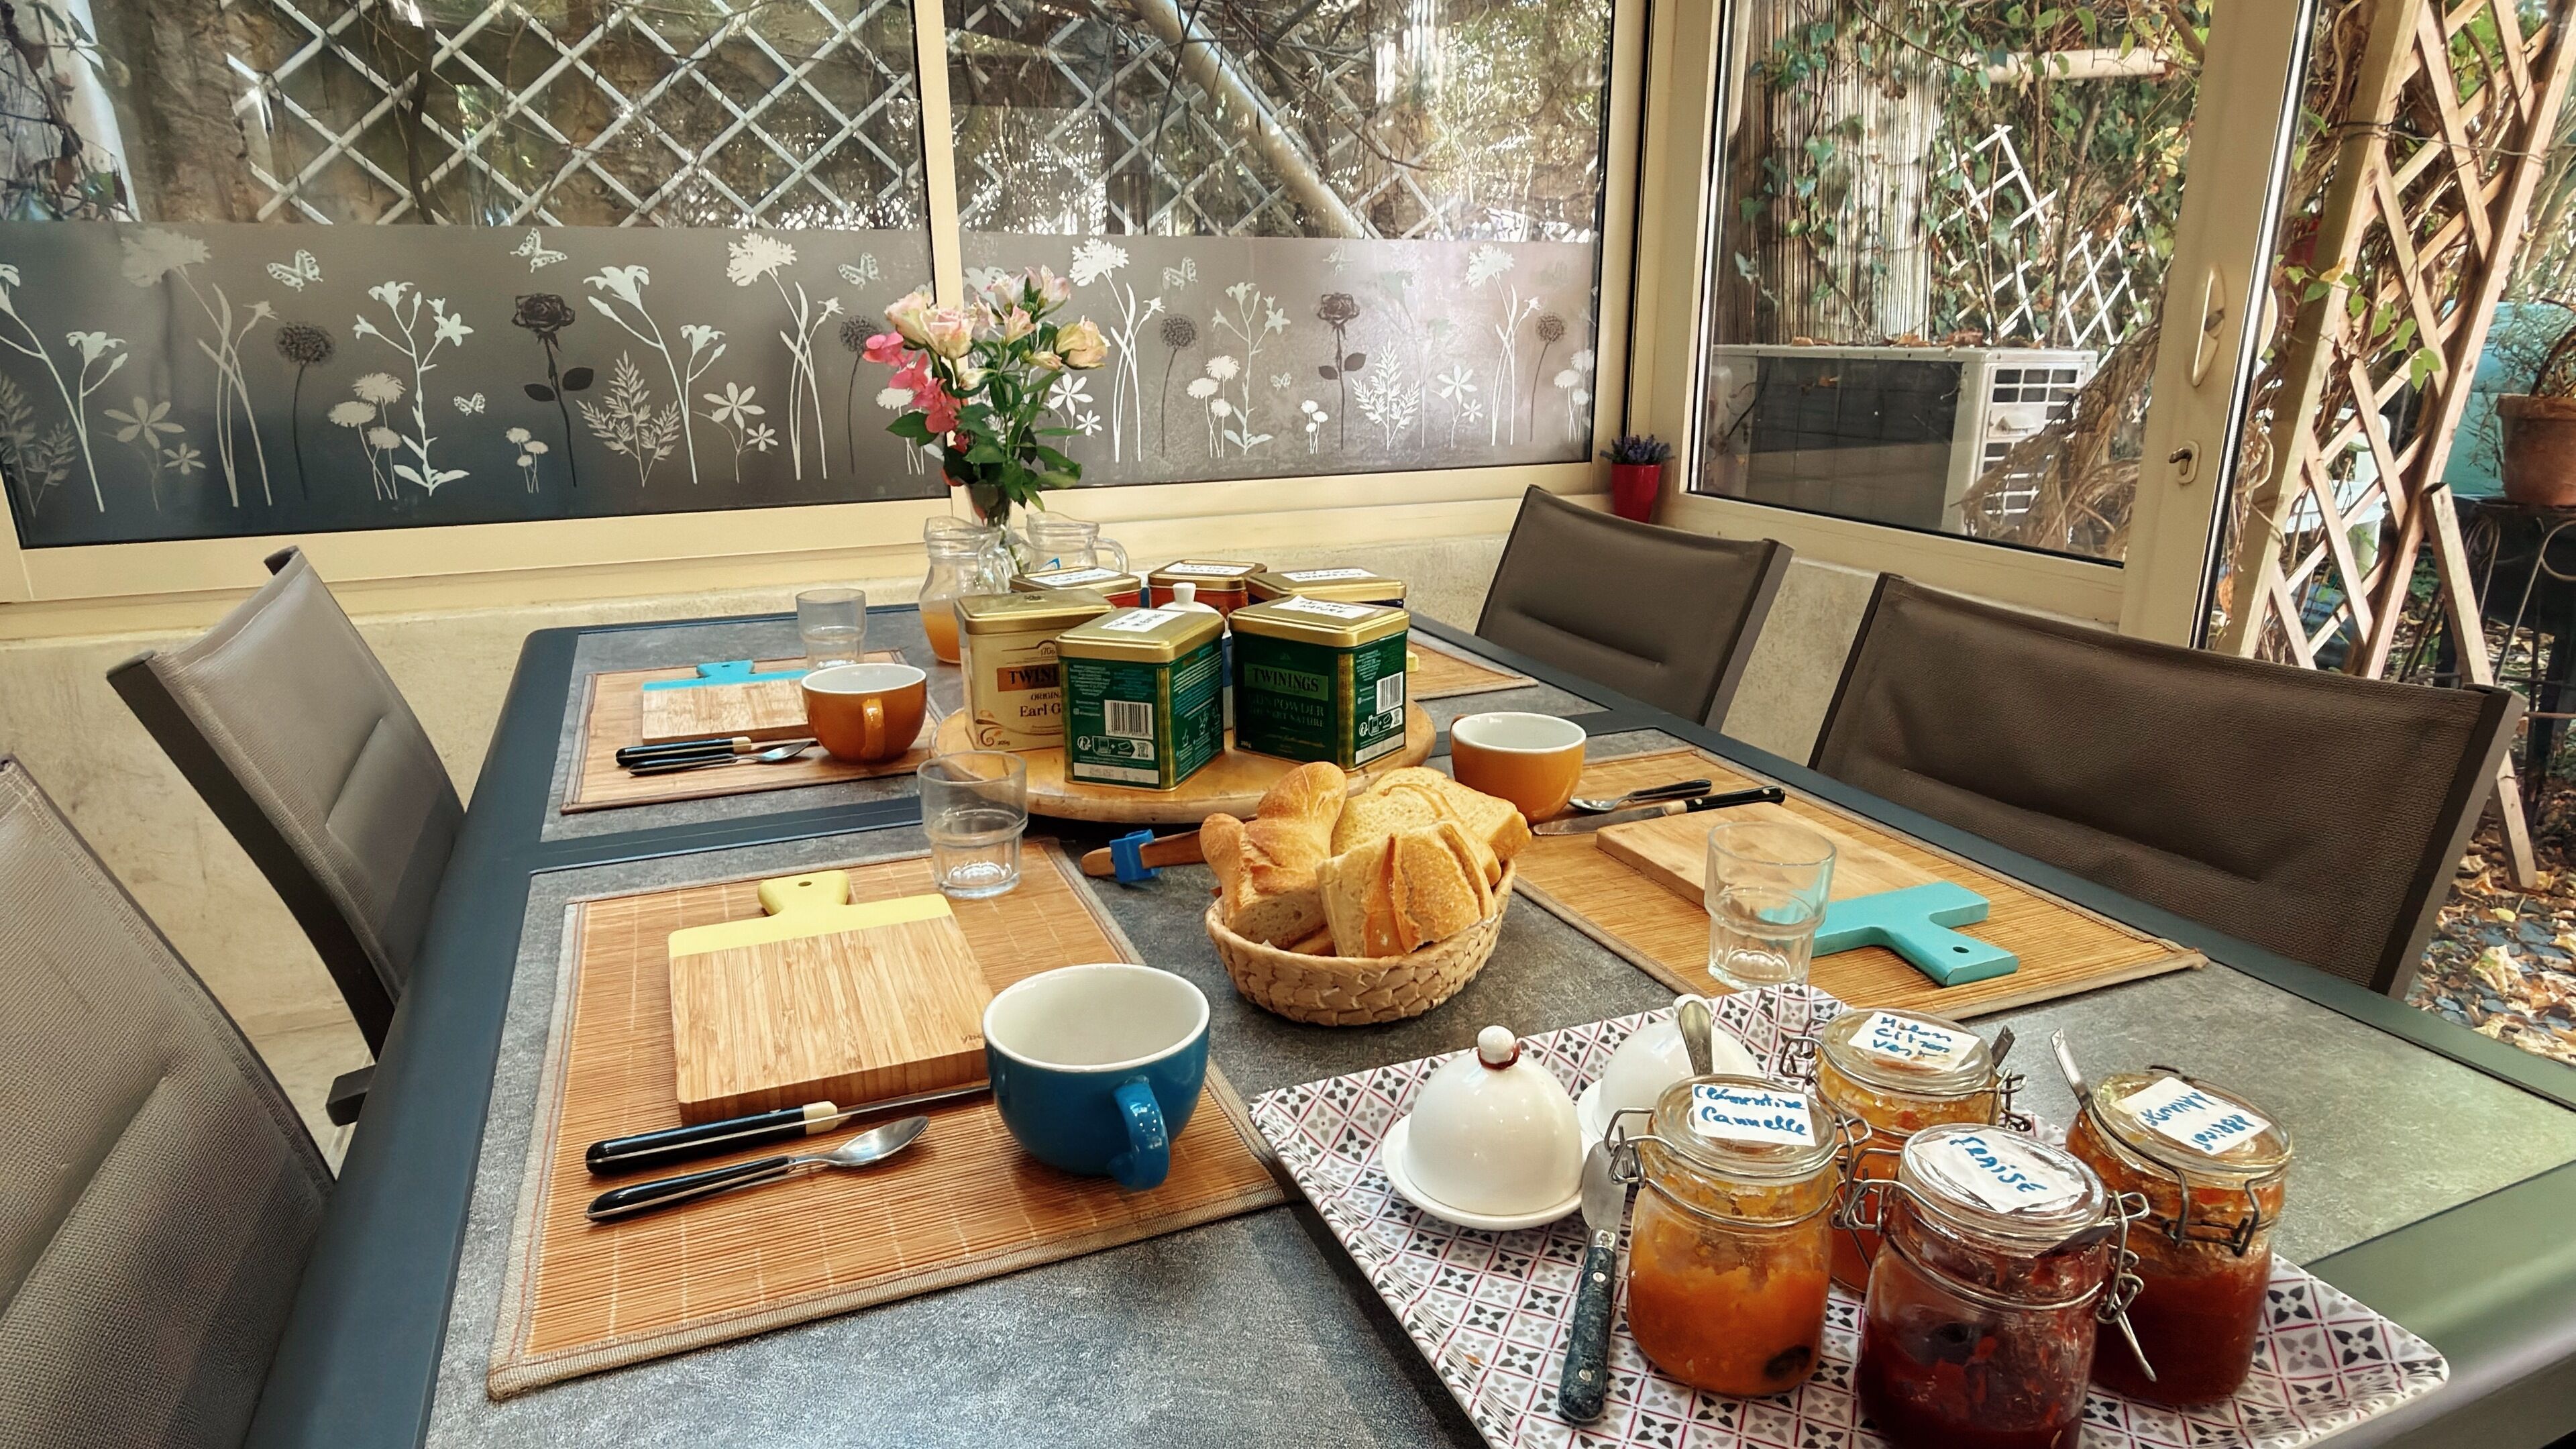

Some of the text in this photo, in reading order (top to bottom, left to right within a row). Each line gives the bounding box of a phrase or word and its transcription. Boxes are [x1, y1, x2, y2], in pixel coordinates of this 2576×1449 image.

[1252, 667, 1320, 693] TWININGS
[1020, 704, 1047, 717] Earl
[1701, 1106, 1807, 1136] Cannelle
